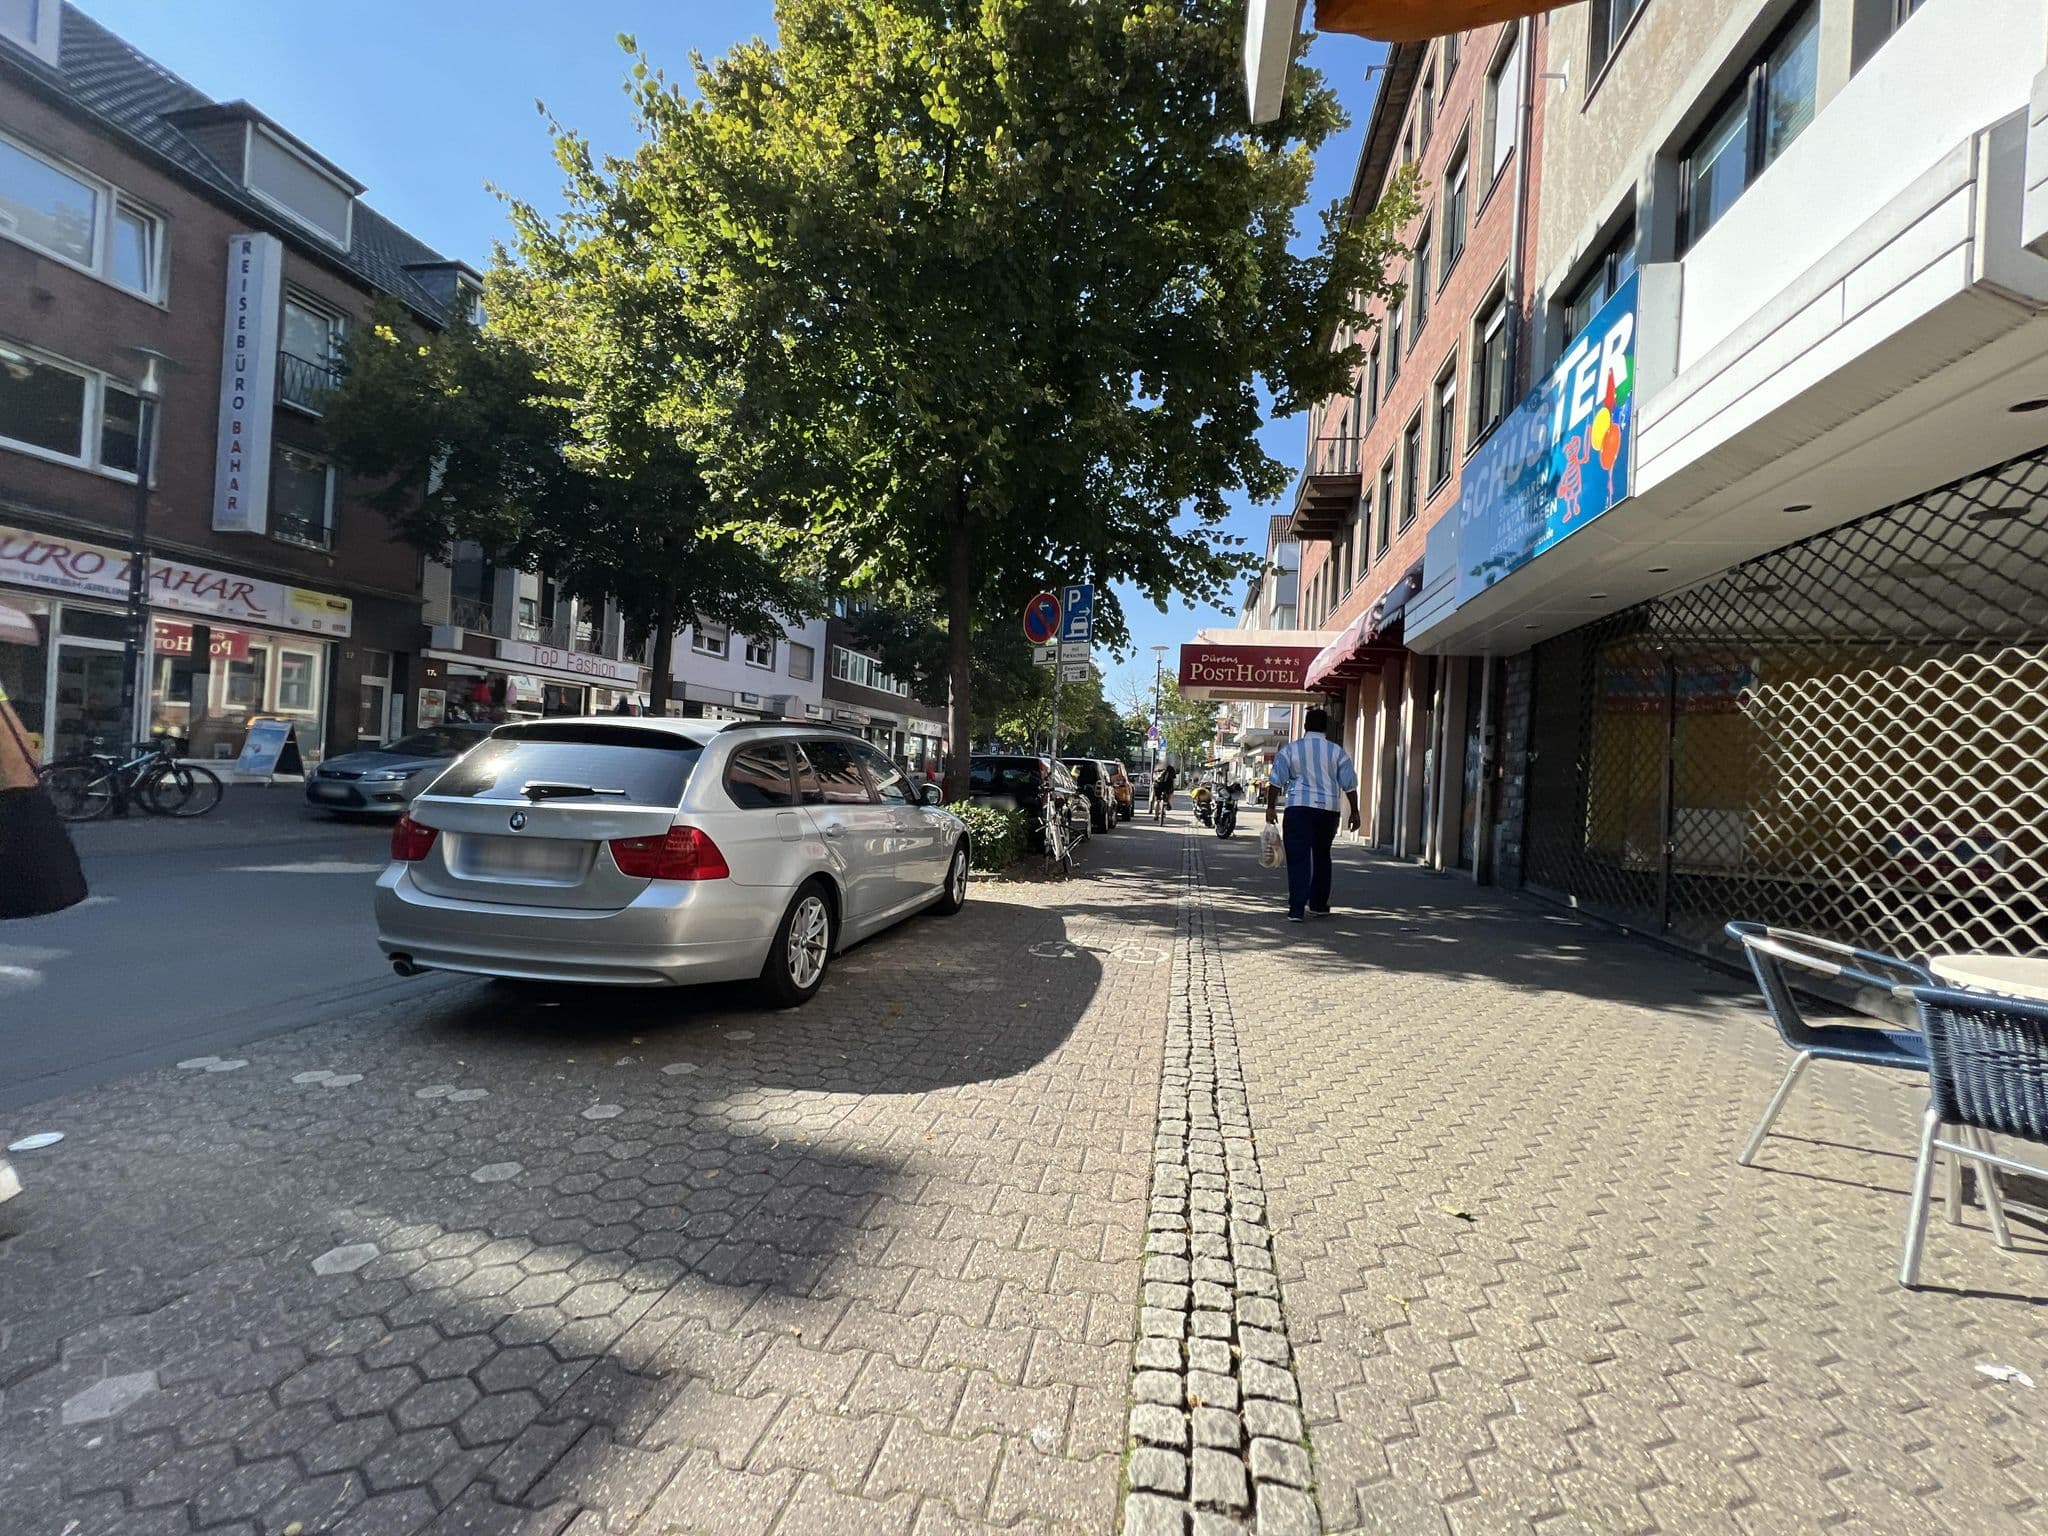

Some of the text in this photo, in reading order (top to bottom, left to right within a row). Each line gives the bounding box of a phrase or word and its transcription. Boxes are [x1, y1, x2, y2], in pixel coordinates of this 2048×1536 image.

[226, 240, 251, 511] REISEBÜRO BAHAR
[1459, 312, 1634, 528] SCHUSTER
[1068, 590, 1081, 612] P
[566, 652, 616, 677] Fashion
[1201, 654, 1239, 665] Dürens
